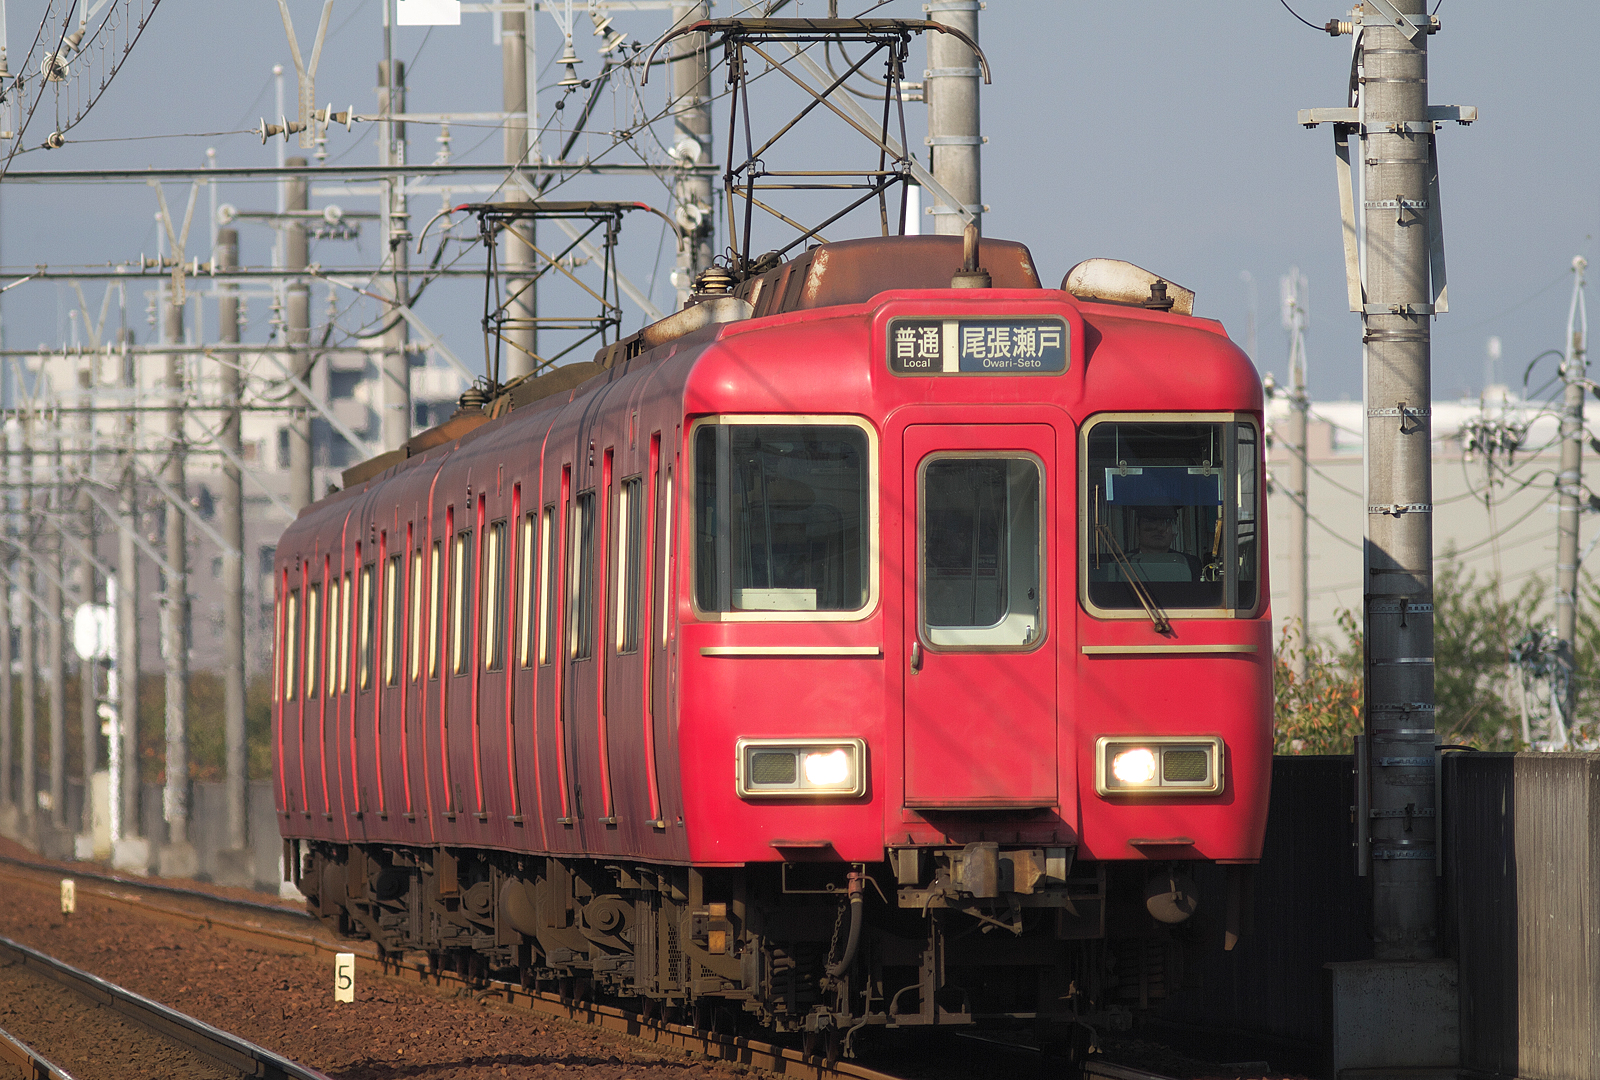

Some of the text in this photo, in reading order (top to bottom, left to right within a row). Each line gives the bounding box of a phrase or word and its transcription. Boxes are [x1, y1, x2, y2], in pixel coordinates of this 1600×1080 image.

[895, 326, 940, 358] 普通
[962, 326, 1062, 358] 尾張瀬戸
[903, 358, 931, 368] Local
[982, 358, 1041, 368] Owari-Seto
[338, 965, 352, 990] 5
